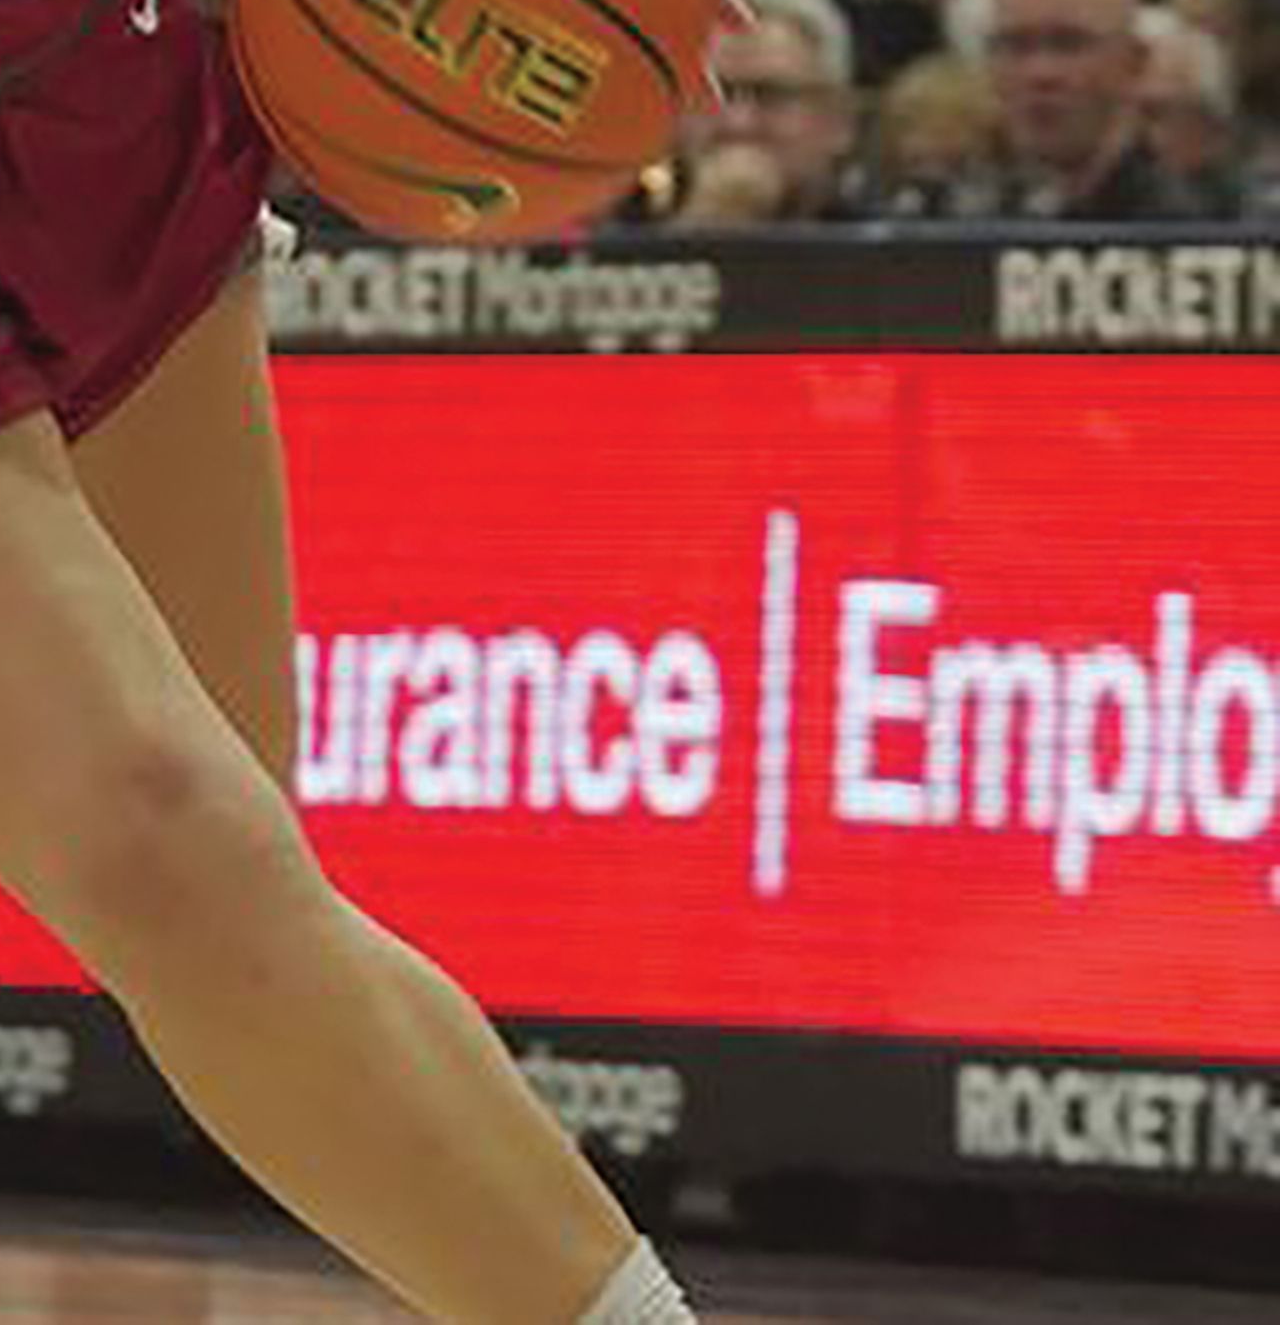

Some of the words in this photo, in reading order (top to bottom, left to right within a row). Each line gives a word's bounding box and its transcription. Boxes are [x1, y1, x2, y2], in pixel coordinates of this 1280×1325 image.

[476, 249, 720, 353] Mortgage
[997, 247, 1242, 343] ROCKET
[294, 623, 724, 816] urance
[835, 578, 1280, 897] Emplo
[957, 1065, 1205, 1167] ROCKET
